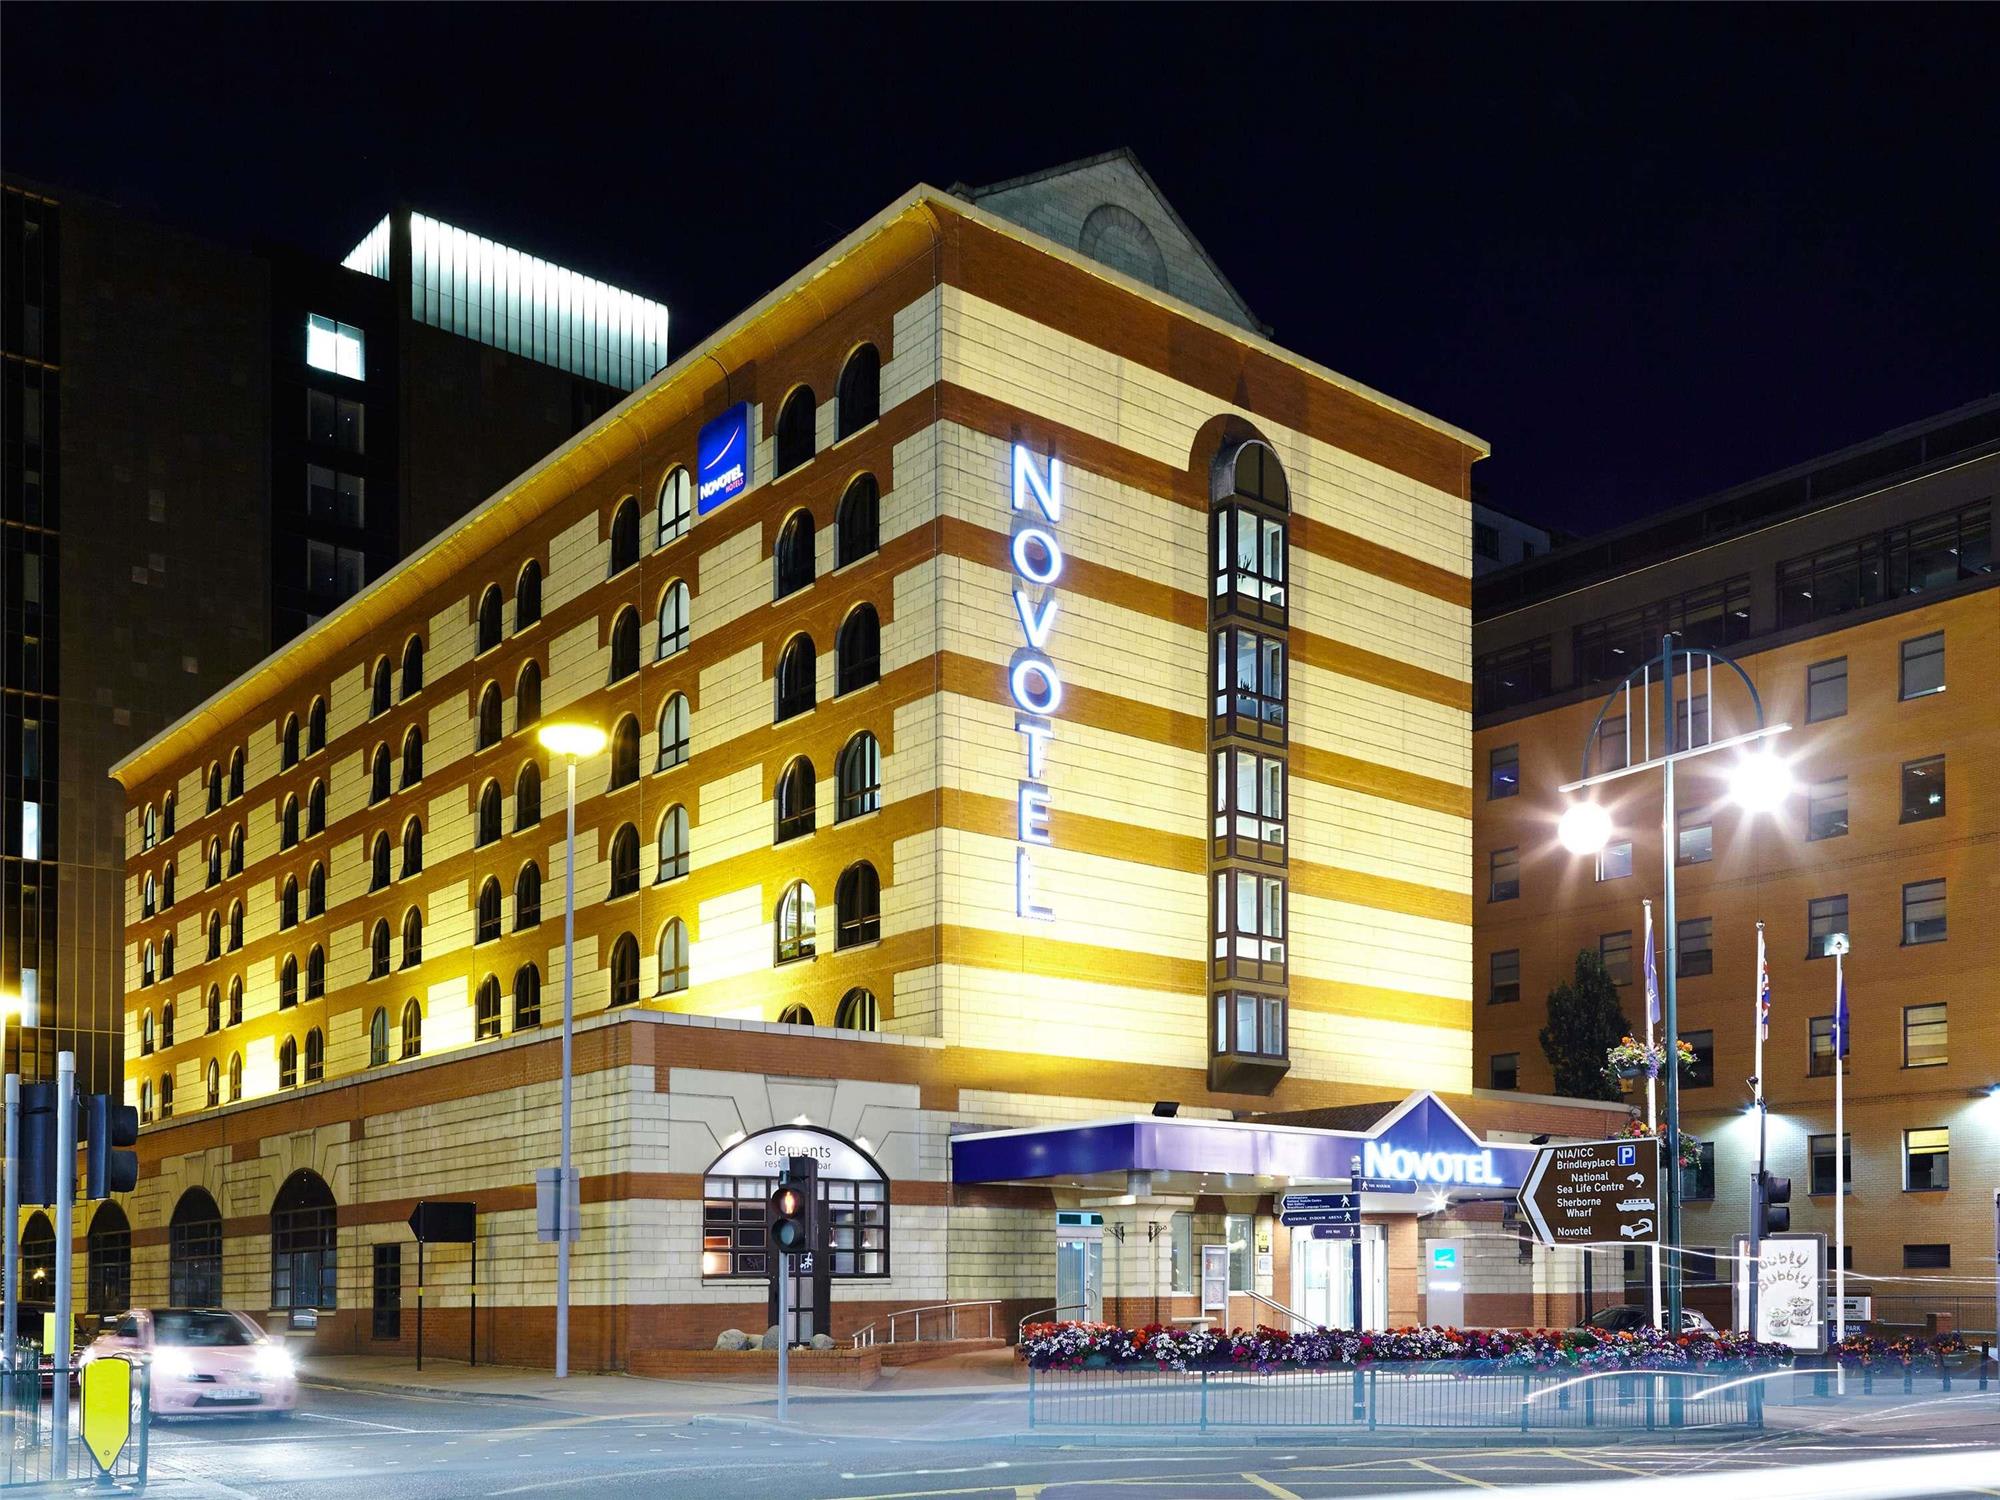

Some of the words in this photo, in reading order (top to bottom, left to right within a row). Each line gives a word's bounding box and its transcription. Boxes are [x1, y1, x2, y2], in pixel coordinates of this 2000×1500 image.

[700, 464, 744, 500] NOVOTEL
[725, 477, 744, 493] HOTELS
[1011, 442, 1062, 922] NOVOTEL
[764, 1141, 831, 1158] elements
[1556, 1147, 1594, 1159] NIA/ICC
[1622, 1147, 1633, 1164] P
[817, 1161, 831, 1170] bar
[1363, 1141, 1502, 1184] NOVOTEL
[1556, 1158, 1616, 1170] Brindleyplace
[1571, 1171, 1609, 1182] National
[1557, 1184, 1573, 1194] Sea
[1576, 1183, 1592, 1193] Life
[1594, 1182, 1625, 1192] Centre
[1557, 1197, 1602, 1208] Sherborne
[1566, 1208, 1592, 1218] Wharf
[1557, 1226, 1592, 1236] Novotel
